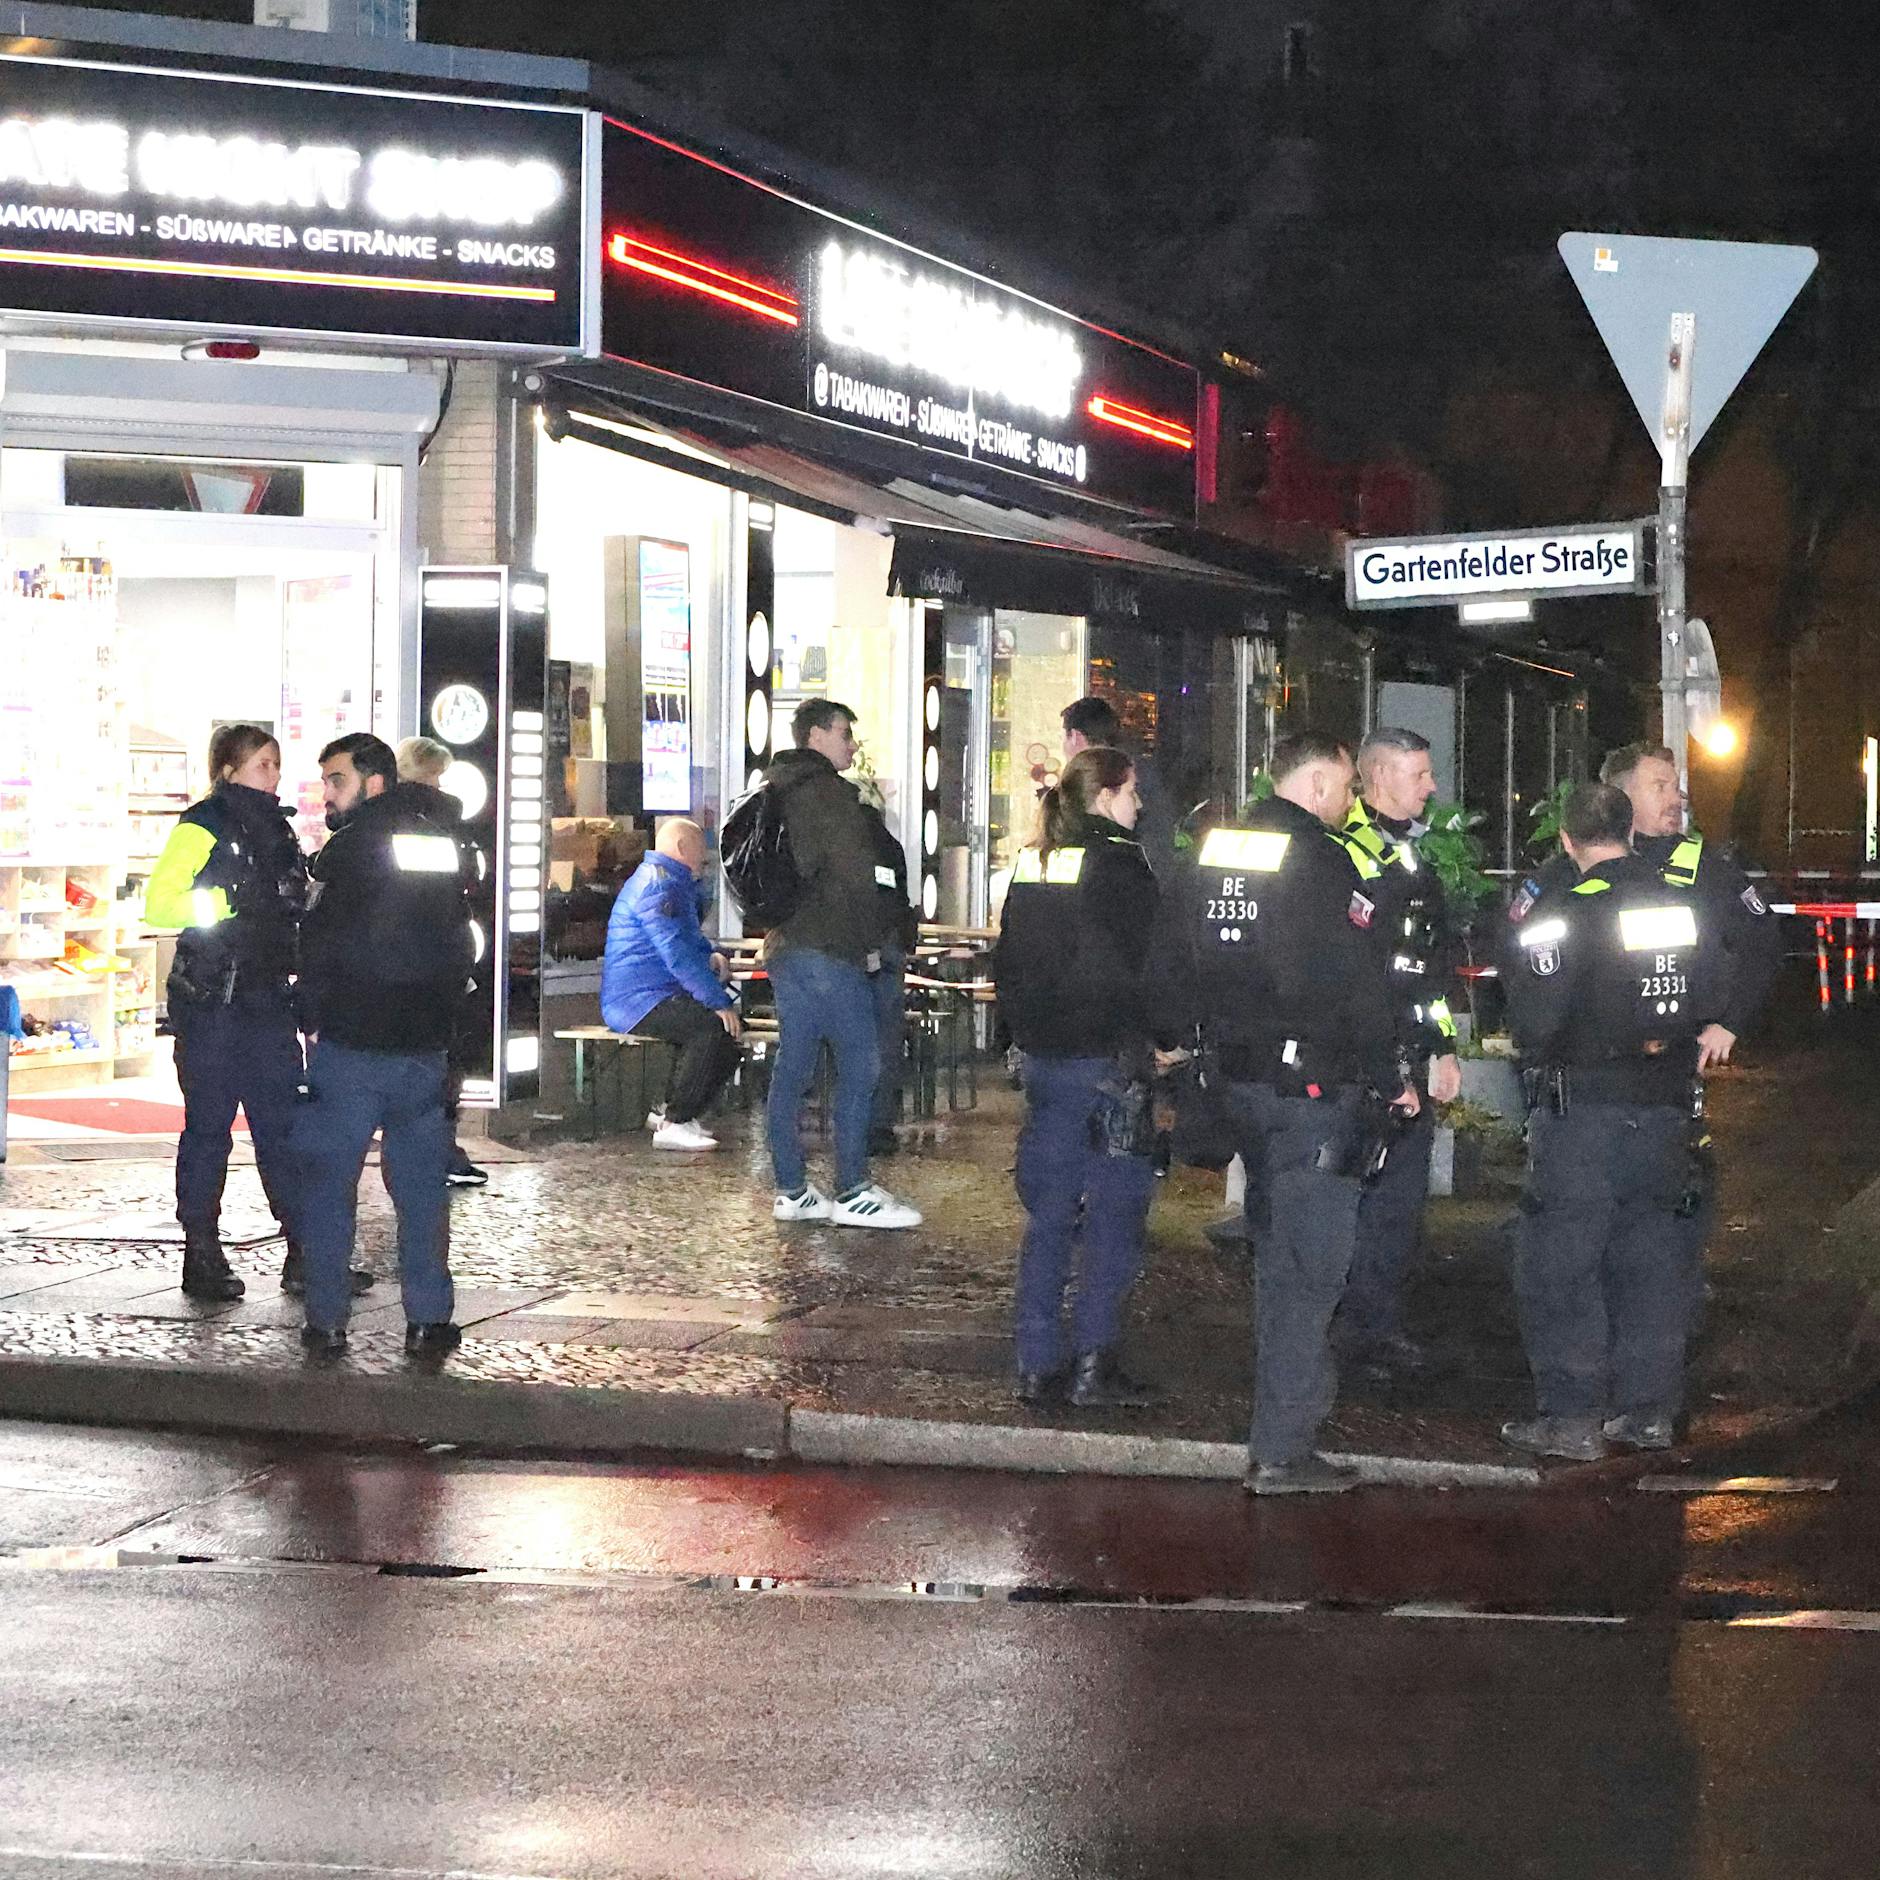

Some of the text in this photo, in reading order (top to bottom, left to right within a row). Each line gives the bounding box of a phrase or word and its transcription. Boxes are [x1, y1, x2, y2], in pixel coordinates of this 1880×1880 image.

[303, 227, 437, 260] GETRÄNKE
[457, 239, 555, 269] SNACKS
[829, 372, 910, 428] TABAKWAREN
[978, 418, 1032, 464] GETRÄNKE
[1363, 539, 1629, 584] Gartenfelder Straße
[1222, 877, 1245, 897] BE
[1206, 900, 1258, 920] 23330
[1655, 953, 1677, 974] BE
[1641, 975, 1687, 997] 23331
